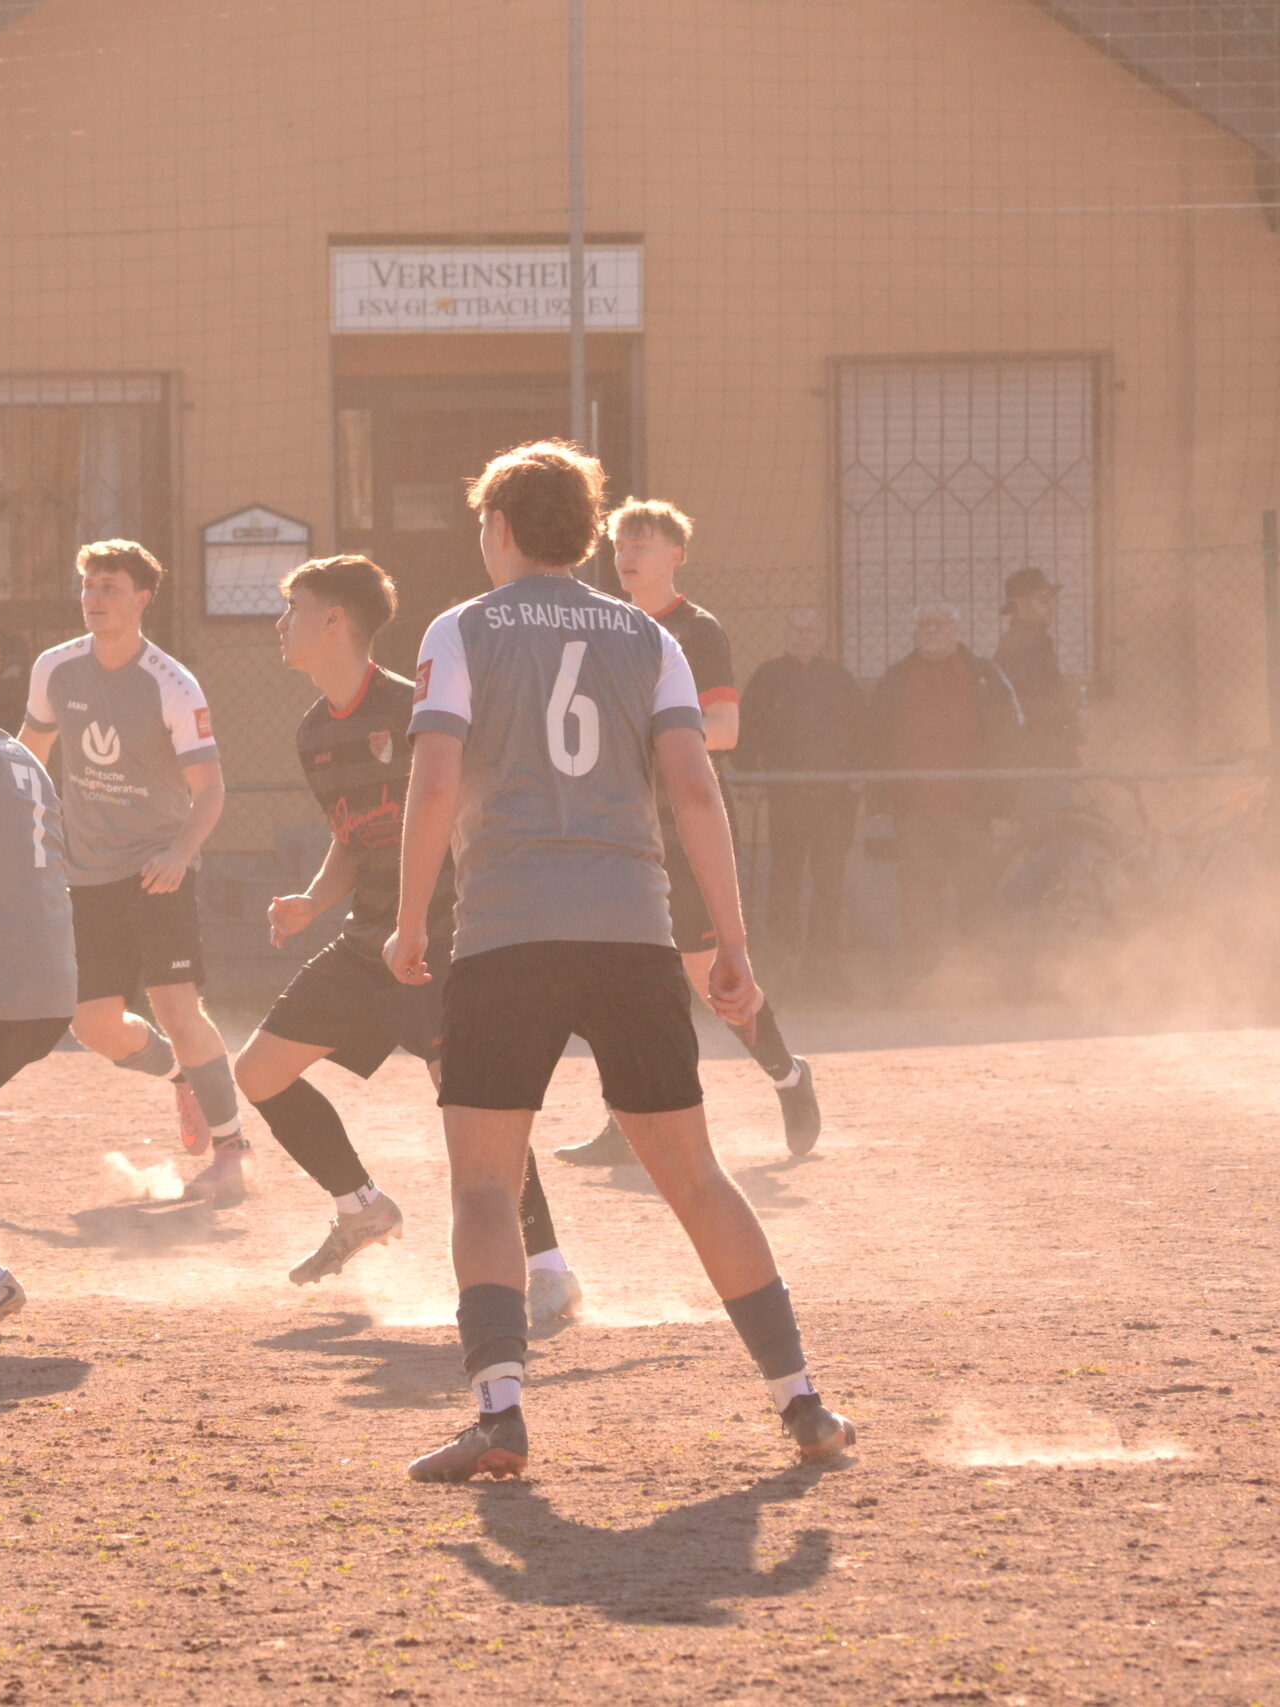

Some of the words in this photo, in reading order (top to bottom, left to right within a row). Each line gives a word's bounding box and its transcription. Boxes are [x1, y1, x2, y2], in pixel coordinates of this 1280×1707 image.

[545, 297, 575, 315] 192
[485, 604, 516, 630] SC
[519, 602, 638, 635] RAUENTHAL
[546, 640, 600, 777] 6
[10, 762, 47, 868] 7
